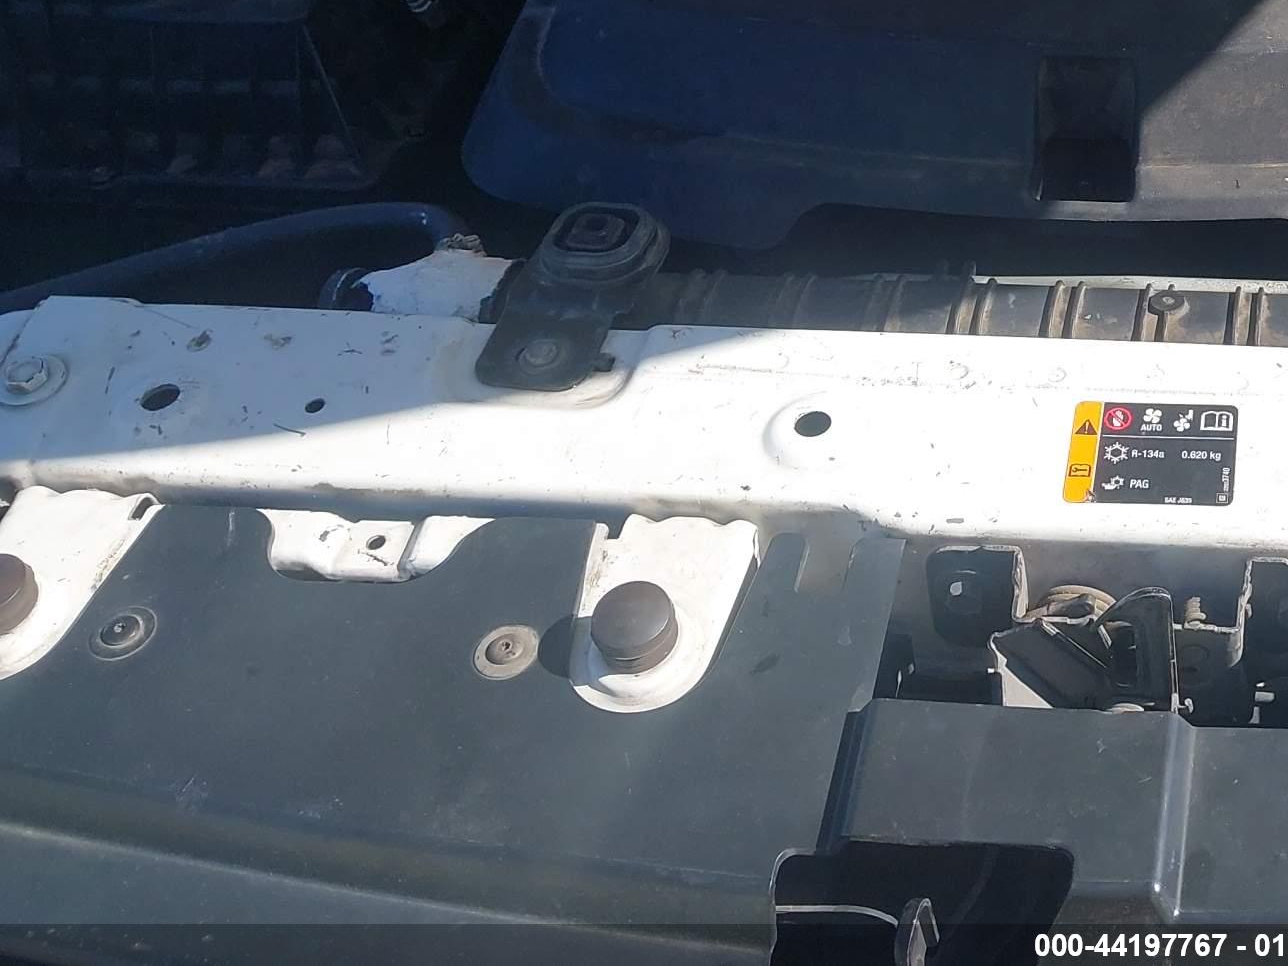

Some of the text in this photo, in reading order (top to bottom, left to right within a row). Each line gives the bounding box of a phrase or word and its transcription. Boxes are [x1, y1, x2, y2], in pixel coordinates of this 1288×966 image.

[1140, 423, 1163, 432] AUTO
[1131, 449, 1222, 462] R-134a 0.620 kg
[1129, 479, 1149, 489] PAG
